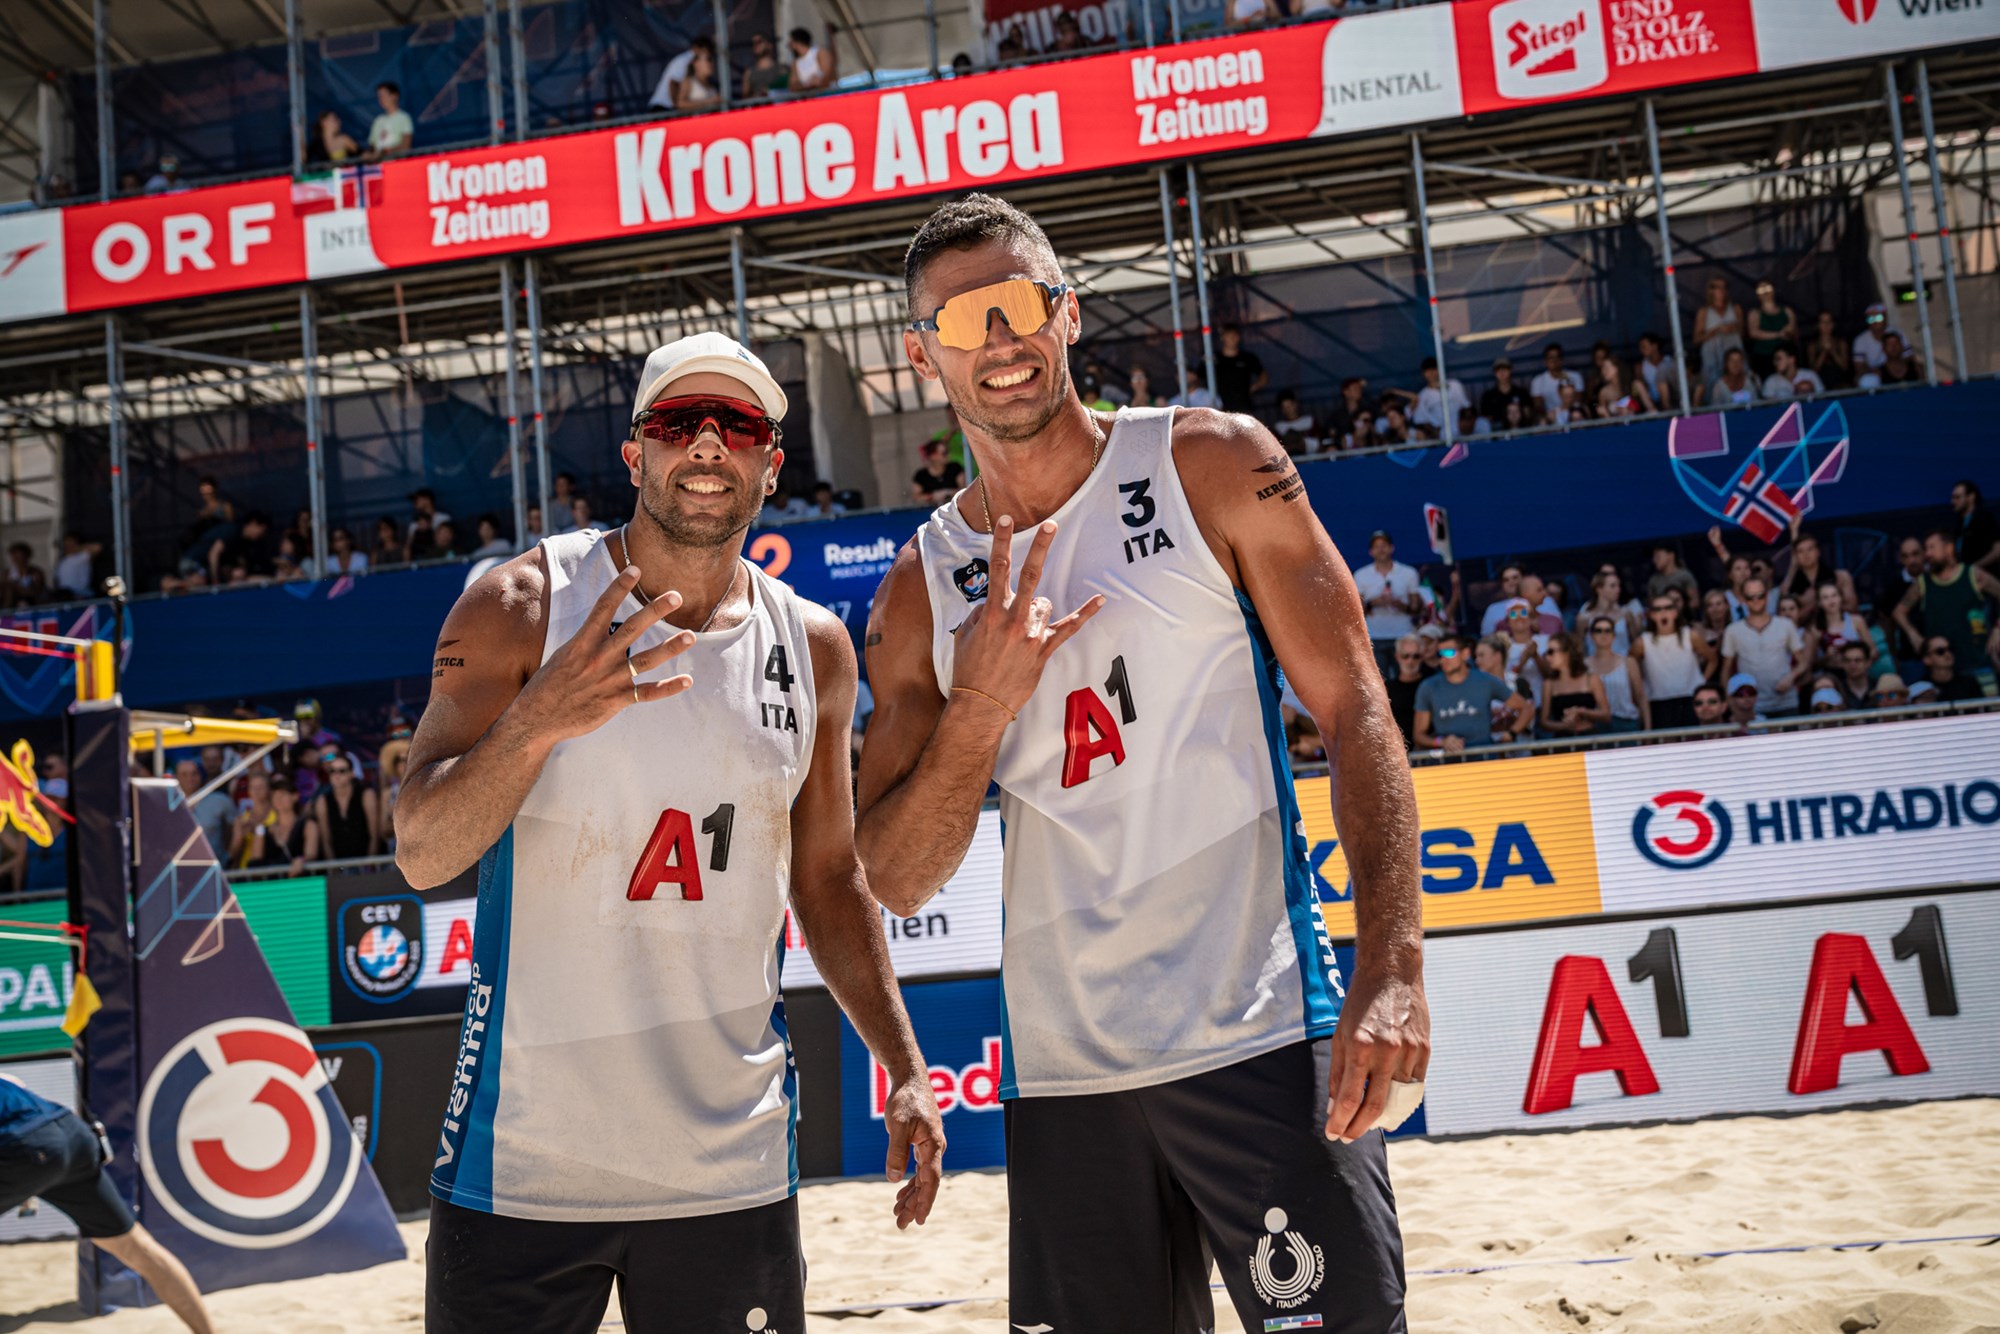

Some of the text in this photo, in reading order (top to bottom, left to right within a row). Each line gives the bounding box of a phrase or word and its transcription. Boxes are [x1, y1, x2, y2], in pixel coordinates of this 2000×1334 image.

[1610, 0, 1673, 23] UND
[1612, 11, 1706, 43] STOLZ
[1506, 9, 1586, 68] Stiegl
[1131, 49, 1264, 100] Kronen
[1323, 70, 1442, 105] INENTAL
[1135, 95, 1269, 146] Zeitung
[427, 155, 547, 204] Kronen
[614, 90, 1064, 227] Krone Area
[91, 201, 276, 283] ORF
[430, 199, 550, 247] Zeitung
[1118, 477, 1156, 527] 3
[824, 536, 896, 566] Result
[1123, 527, 1175, 564] ITA
[764, 644, 794, 693] 4
[761, 702, 798, 734] ITA
[1061, 655, 1137, 788] A1
[1746, 780, 2000, 845] HITRADIO
[626, 803, 735, 901] A1
[361, 903, 402, 923] CEV
[880, 909, 949, 940] ien
[1522, 904, 1960, 1115] A1 A1
[434, 984, 492, 1170] Vienna
[1276, 1292, 1312, 1309] ITALIANA
